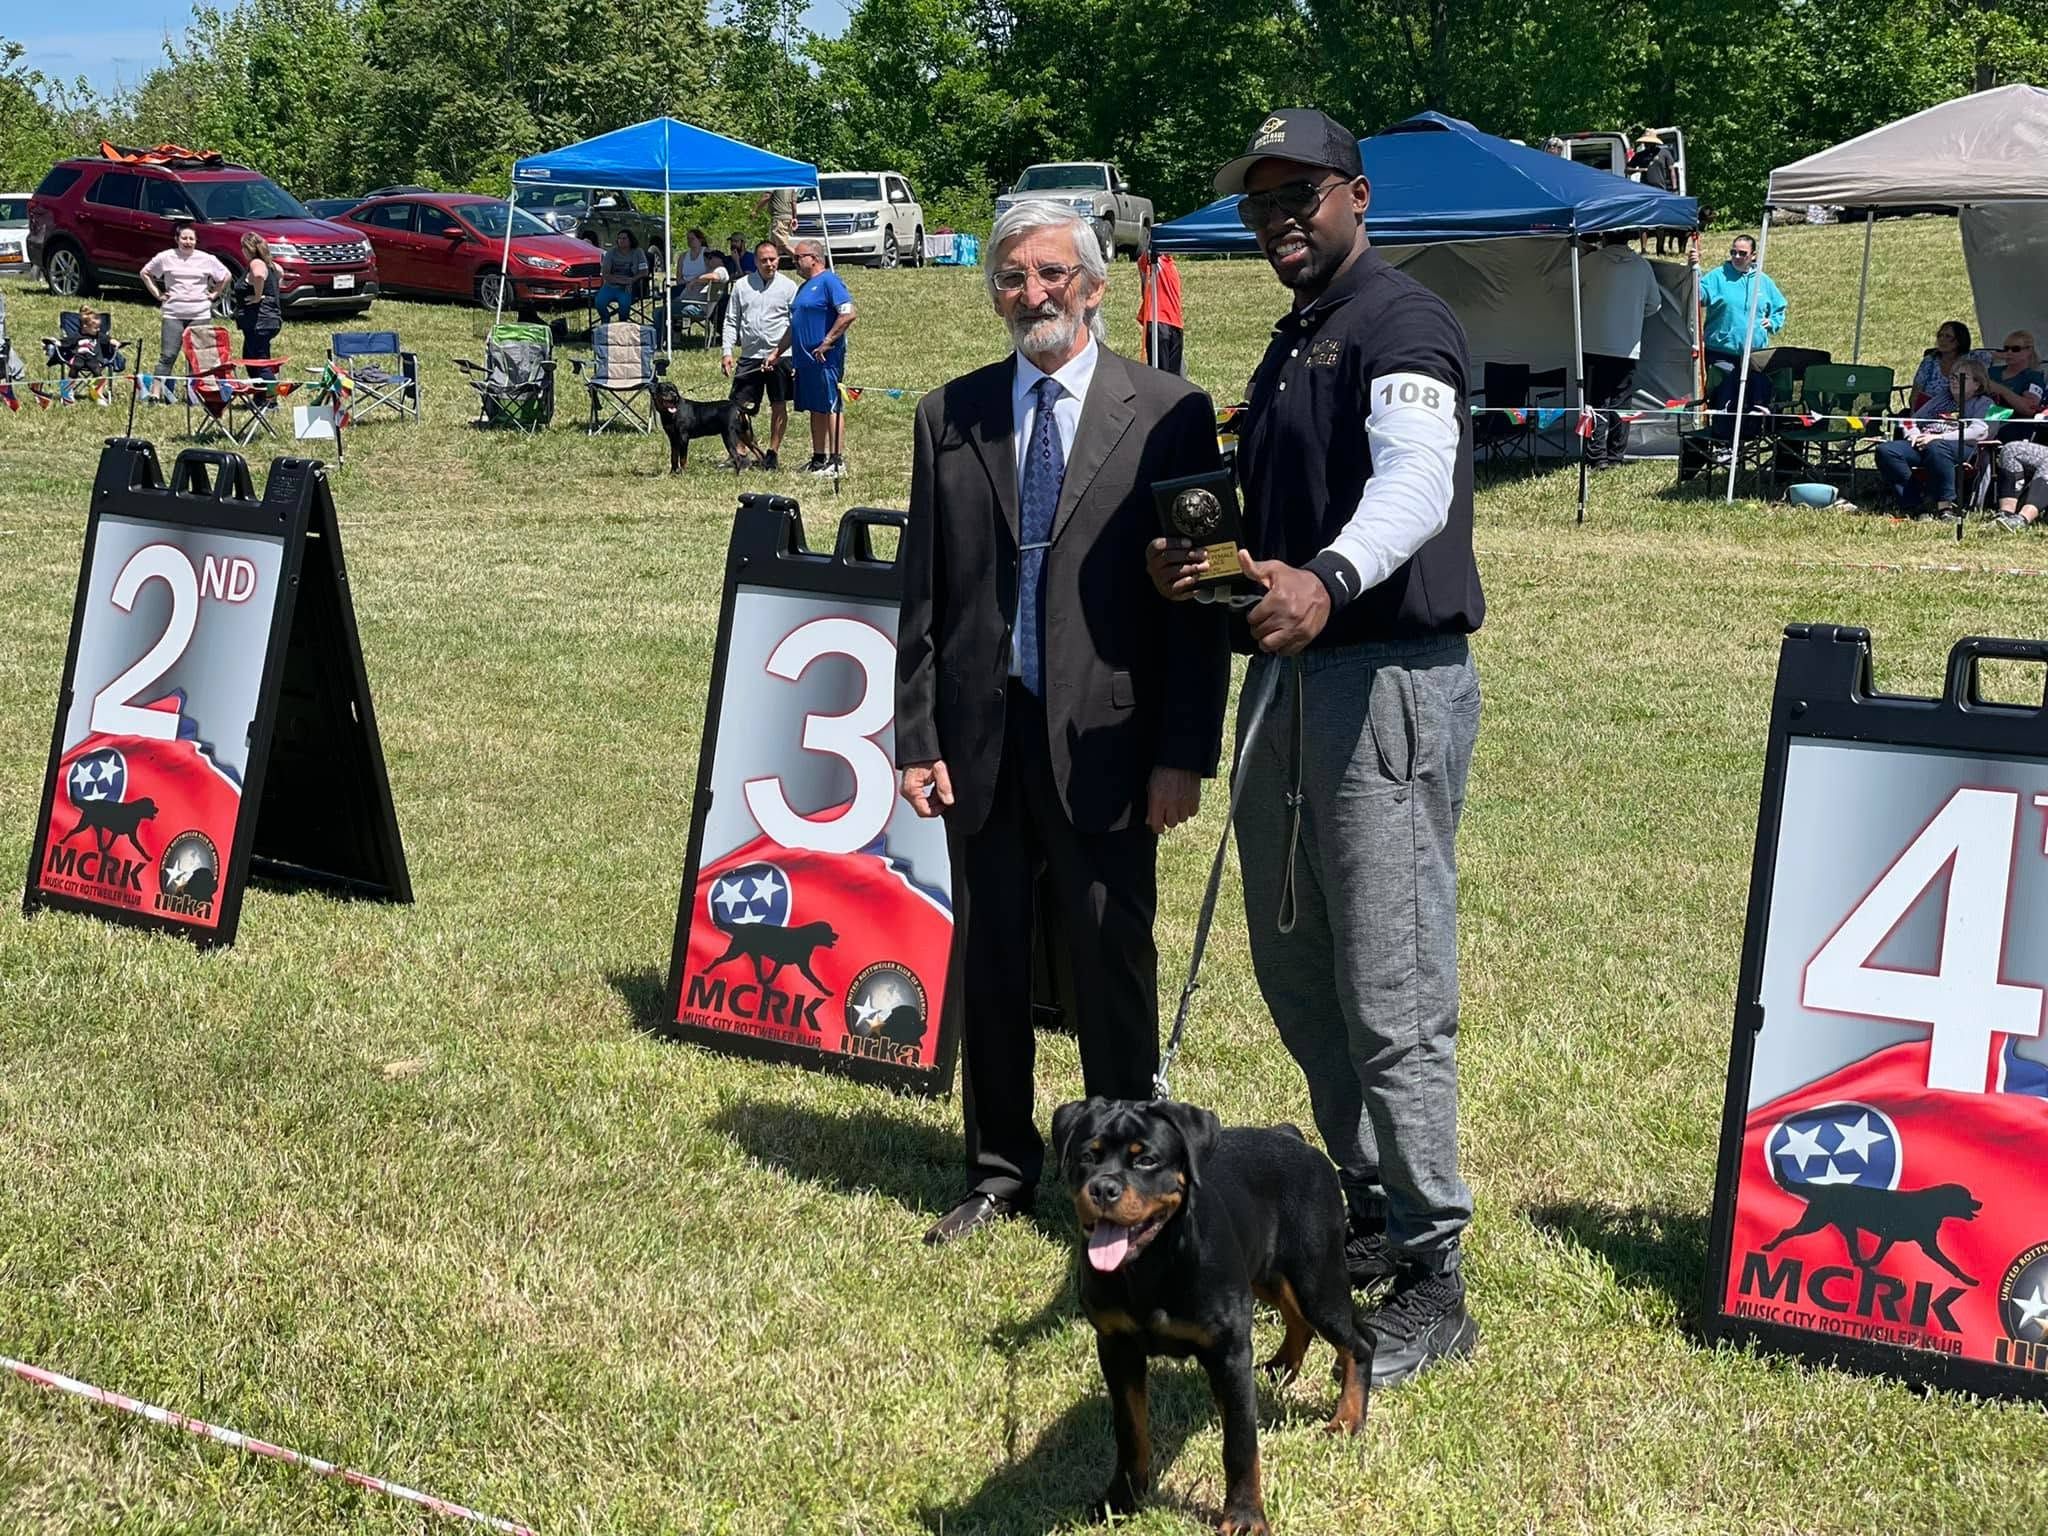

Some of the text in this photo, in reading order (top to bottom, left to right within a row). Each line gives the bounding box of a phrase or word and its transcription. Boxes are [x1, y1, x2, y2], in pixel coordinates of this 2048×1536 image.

[1380, 382, 1440, 409] 108
[47, 844, 147, 892] MCRK
[64, 880, 78, 892] CITY
[686, 975, 827, 1032] MCRK
[846, 962, 927, 1021] UNITED ROTTWEILER KLUB OF AMERICA
[683, 1011, 709, 1027] MUSIC
[712, 1017, 733, 1031] CITY
[735, 1021, 794, 1041] ROTTWEILER
[1738, 1251, 1968, 1334] MCRK
[2001, 1265, 2020, 1301] UNITED
[1735, 1301, 1963, 1355] MUSIC CITY ROTTWEILER KLUB
